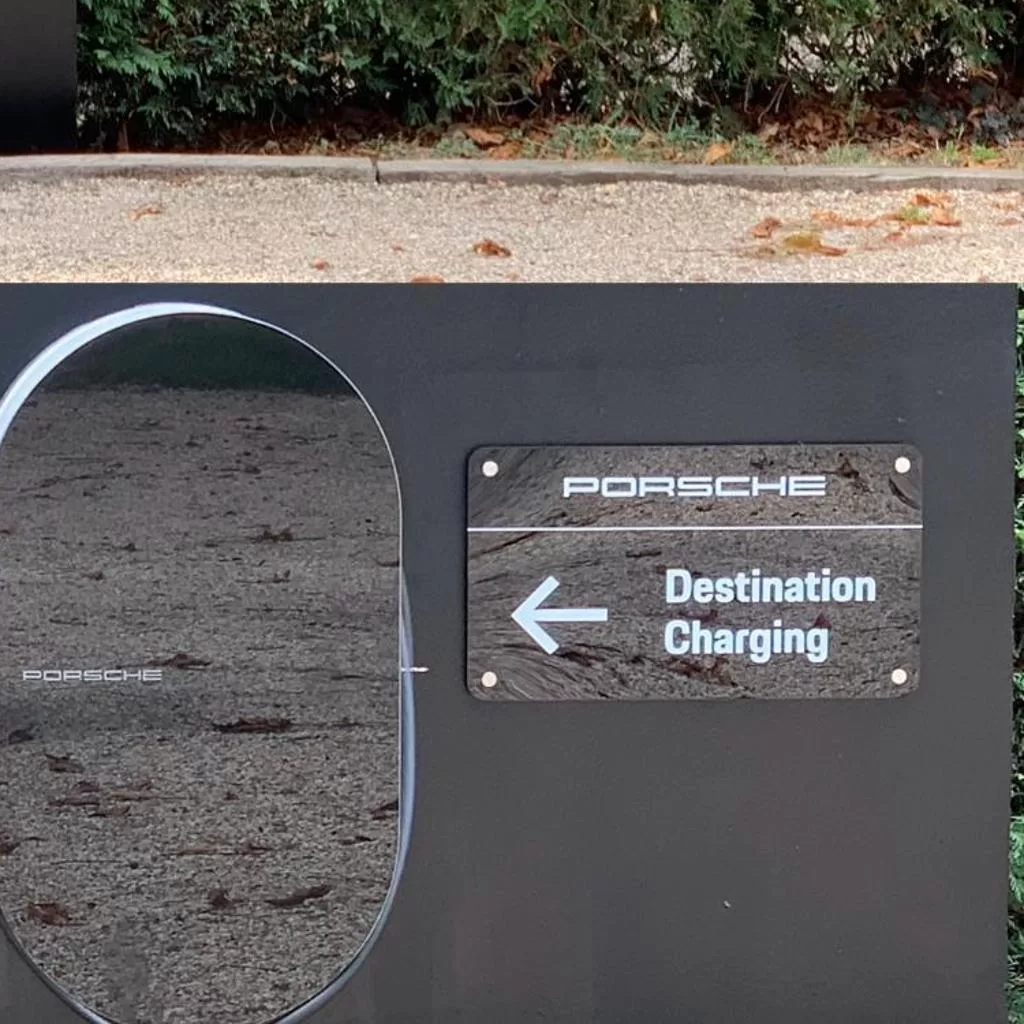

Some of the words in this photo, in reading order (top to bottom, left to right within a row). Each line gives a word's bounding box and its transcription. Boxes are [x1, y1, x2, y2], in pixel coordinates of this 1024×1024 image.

[563, 476, 826, 498] PORSCHE
[665, 568, 877, 604] Destination
[664, 619, 830, 664] Charging
[22, 669, 163, 682] PORSCHE
